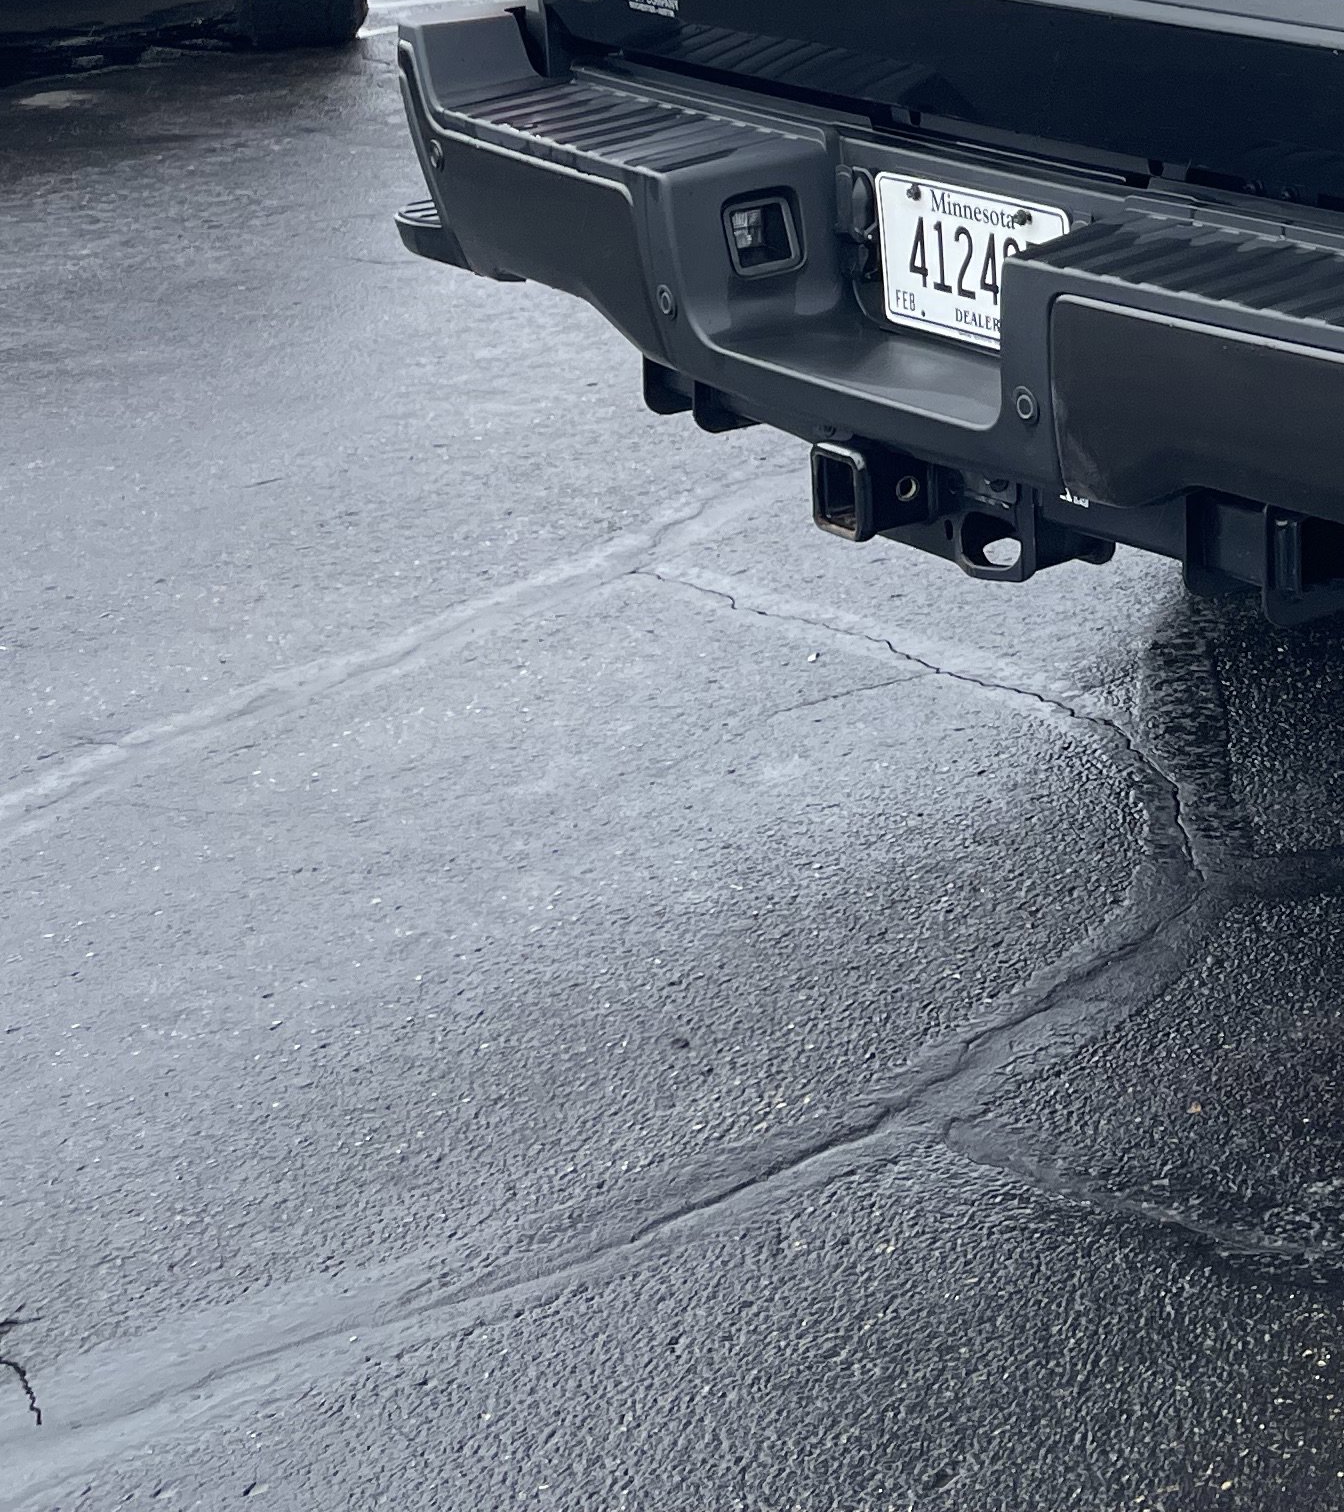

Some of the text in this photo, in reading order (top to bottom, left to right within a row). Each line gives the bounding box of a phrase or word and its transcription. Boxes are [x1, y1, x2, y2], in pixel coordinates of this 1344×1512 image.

[930, 189, 1016, 231] Minnesota
[909, 215, 1020, 306] 4124
[895, 289, 916, 312] FEB
[955, 307, 1001, 334] DEALER
